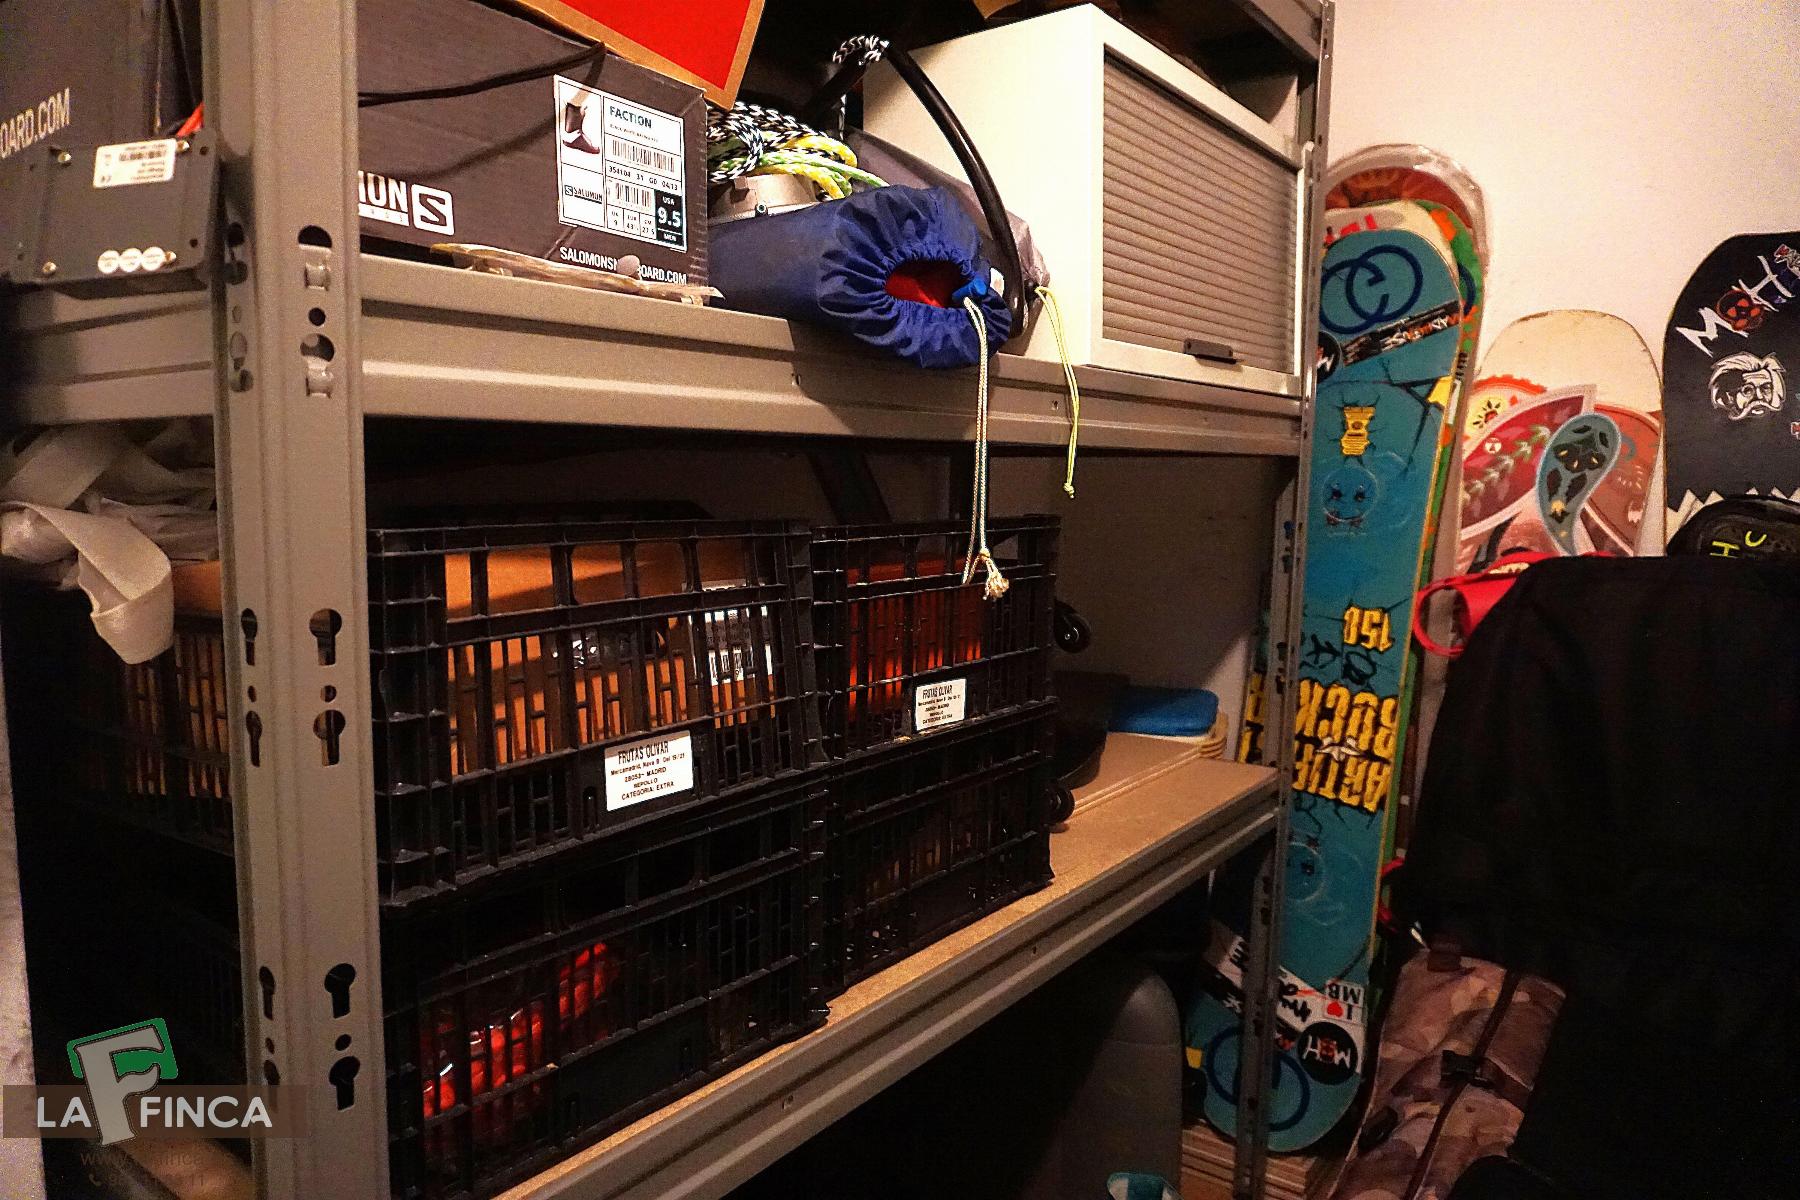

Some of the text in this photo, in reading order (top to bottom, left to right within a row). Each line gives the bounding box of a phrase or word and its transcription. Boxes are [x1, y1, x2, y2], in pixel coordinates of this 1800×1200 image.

[609, 105, 652, 128] FACTION
[358, 170, 408, 213] ON
[657, 206, 681, 228] 9.5
[1343, 605, 1393, 651] 150
[618, 741, 668, 764] FRUTAS OLIVAR
[646, 766, 667, 777] MADRID
[656, 780, 675, 791] EXTRA
